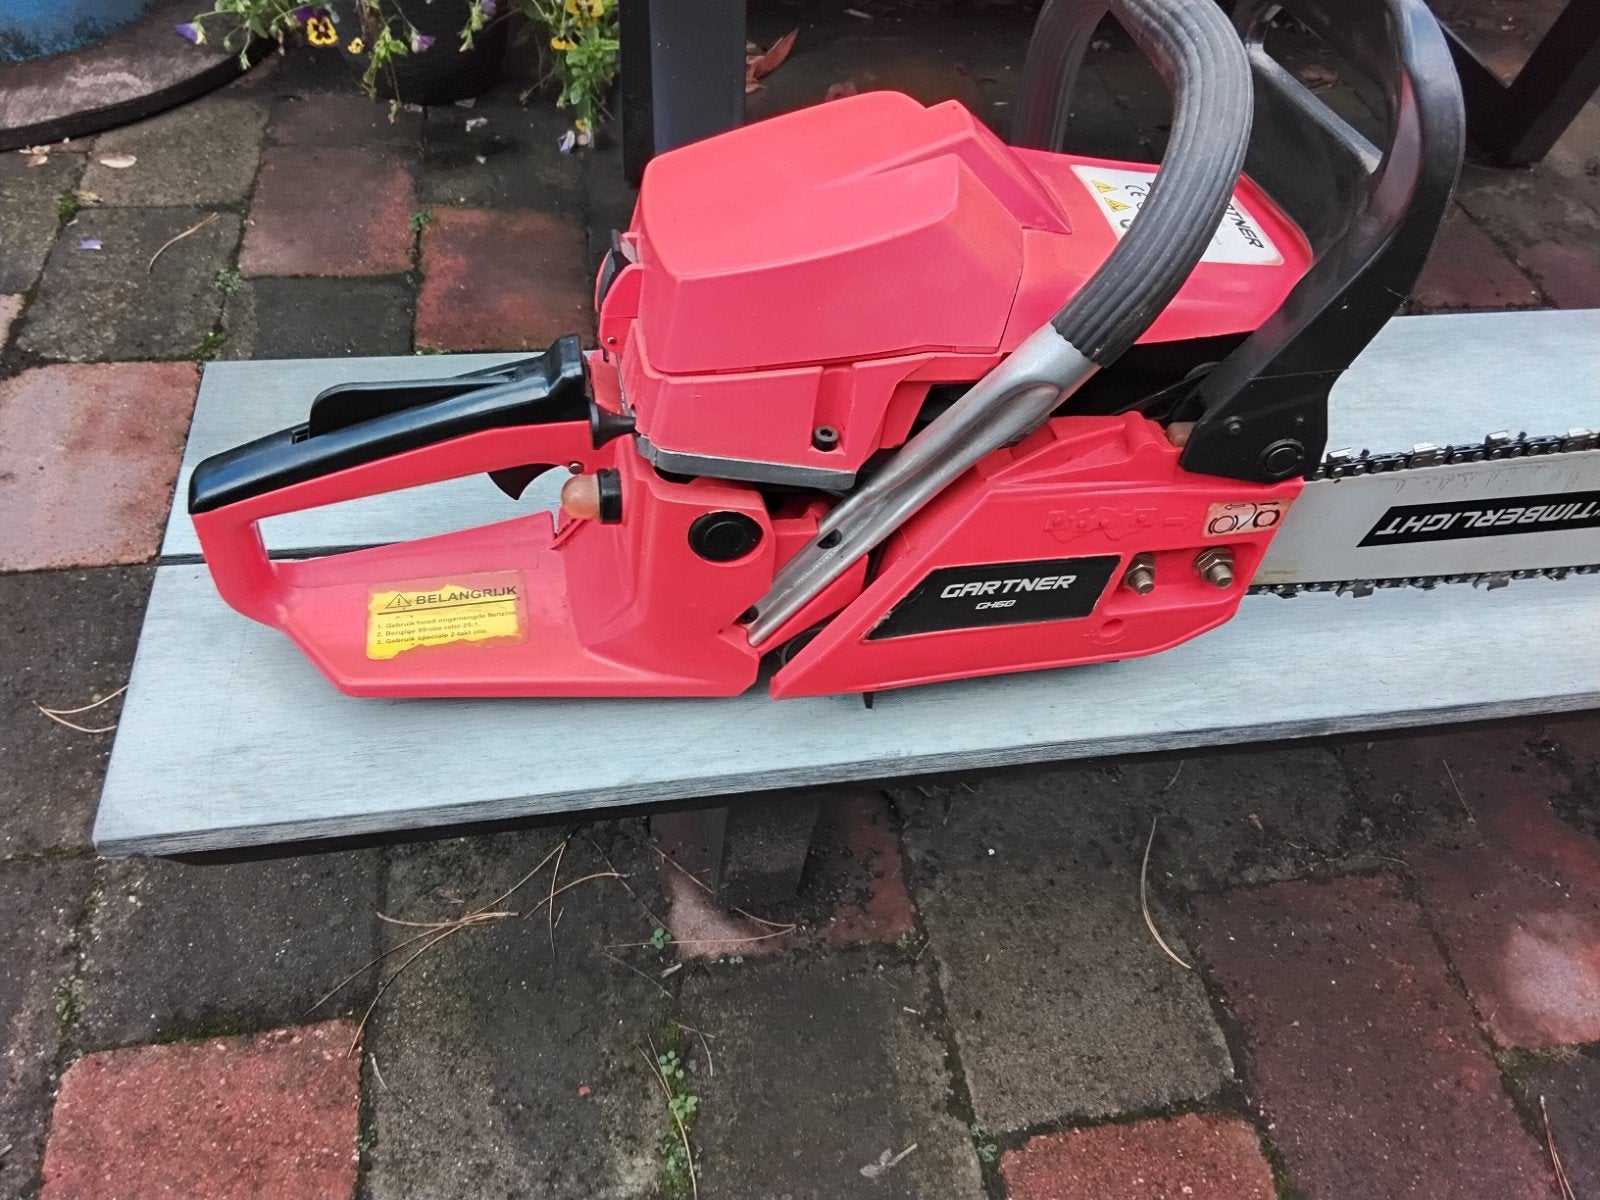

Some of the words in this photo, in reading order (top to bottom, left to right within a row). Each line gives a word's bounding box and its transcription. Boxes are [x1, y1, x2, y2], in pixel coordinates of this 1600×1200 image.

[1225, 203, 1265, 249] RTNER
[1375, 501, 1597, 536] TIMBERLIGHT
[416, 586, 518, 605] BELANGRIJK
[940, 574, 1077, 599] GARTNER
[974, 599, 1017, 610] GH60
[385, 621, 415, 629] Gebruik
[438, 613, 486, 623] ongemengde
[385, 636, 415, 644] Gebruik
[417, 633, 449, 641] speciale
